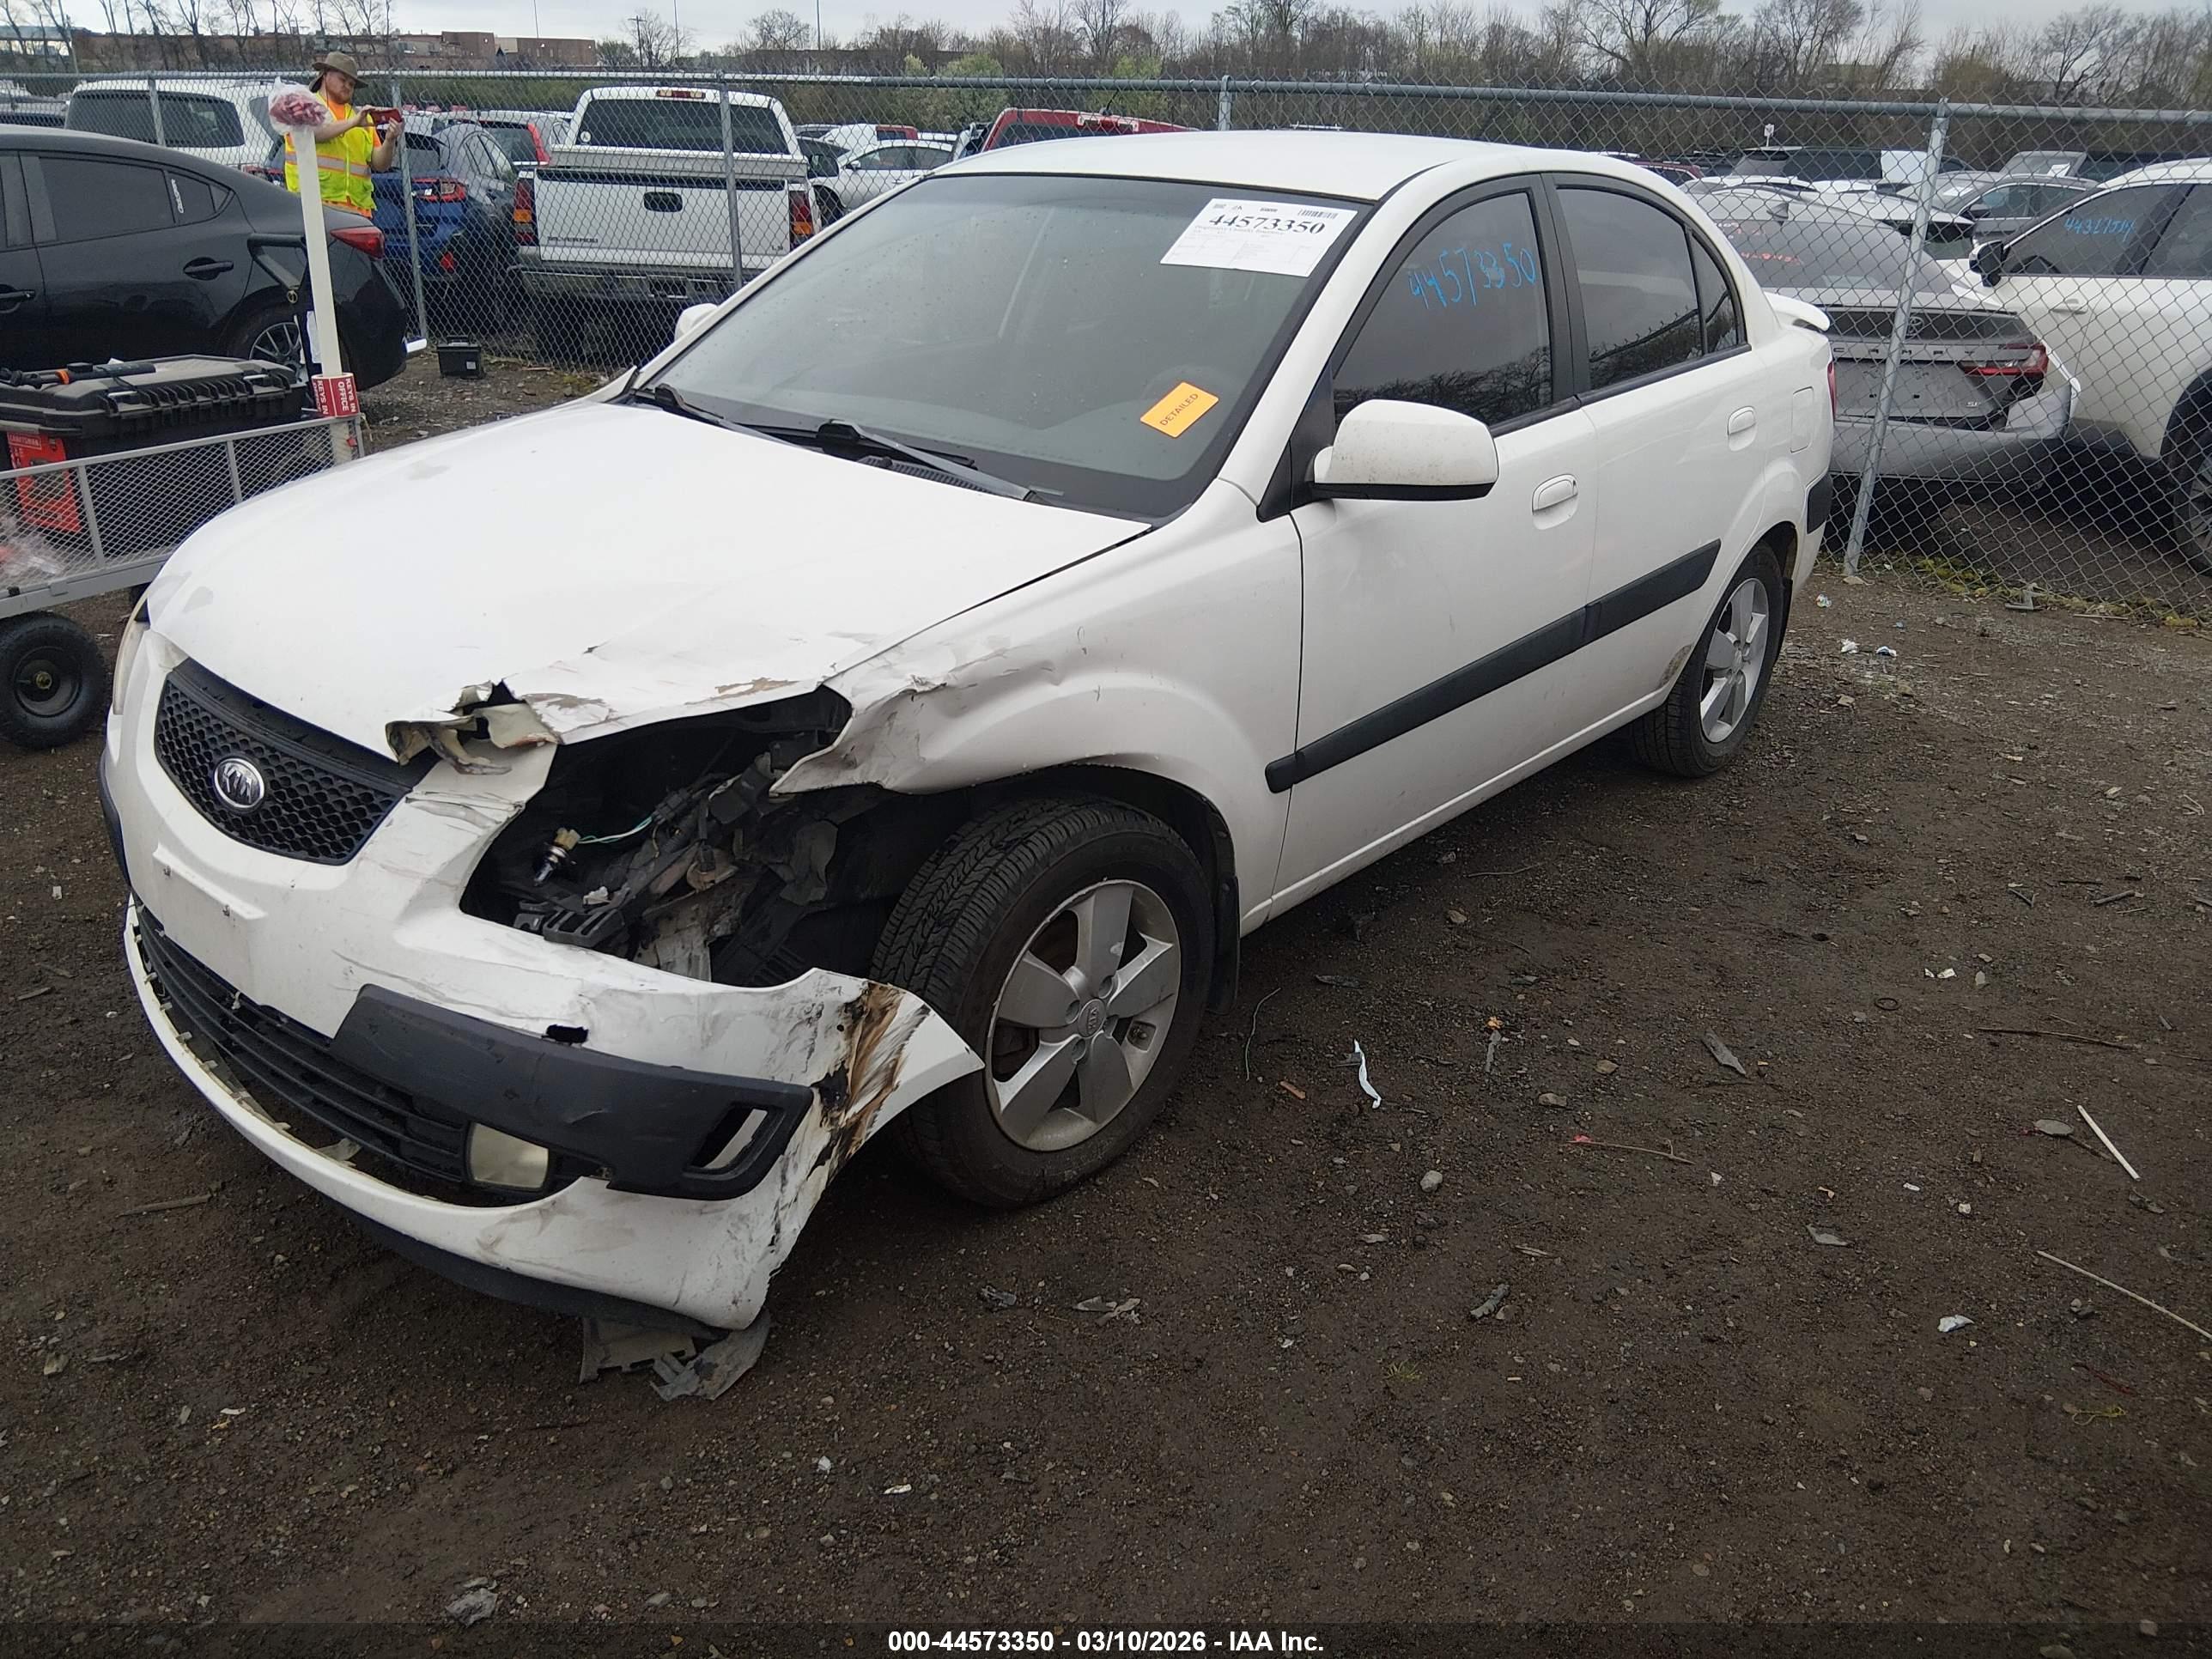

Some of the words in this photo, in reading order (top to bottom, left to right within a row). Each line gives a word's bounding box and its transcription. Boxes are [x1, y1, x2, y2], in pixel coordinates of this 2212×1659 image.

[1209, 214, 1326, 234] 44573350
[1408, 243, 1536, 309] 44573350
[318, 380, 326, 404] KEYS
[337, 381, 349, 411] OFFICE
[345, 378, 355, 401] KEYS
[321, 405, 329, 415] IN
[349, 403, 356, 413] IN
[1159, 392, 1199, 426] DETAILED
